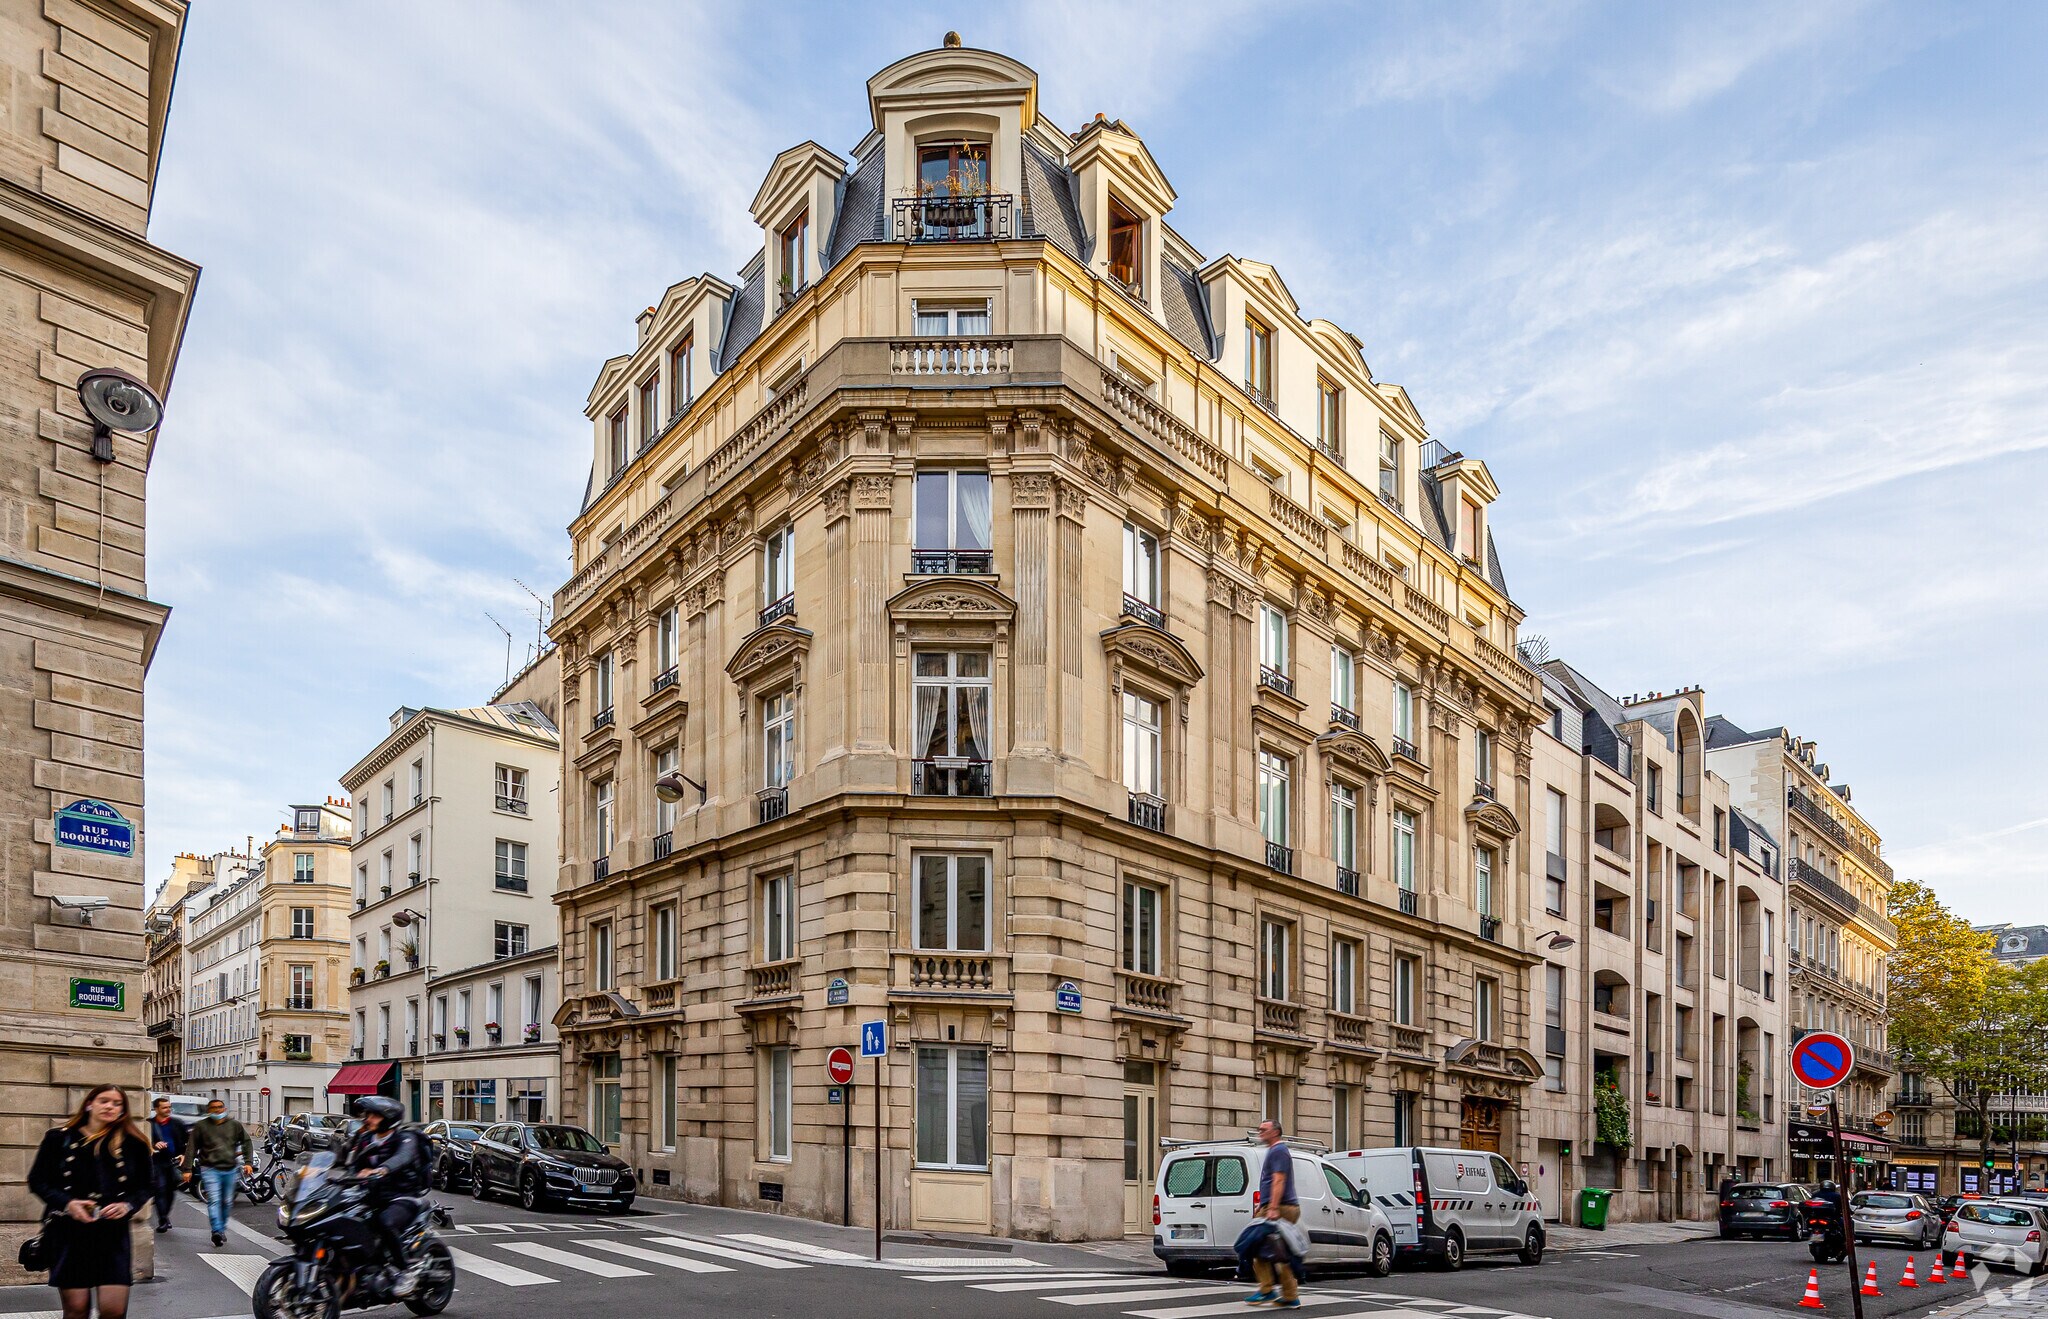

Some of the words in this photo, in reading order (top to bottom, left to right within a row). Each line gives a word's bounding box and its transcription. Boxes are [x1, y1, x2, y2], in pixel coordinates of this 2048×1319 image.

[82, 824, 109, 836] RUE
[60, 831, 130, 849] ROQUÉPINE
[90, 986, 105, 994] RUE
[78, 993, 117, 1003] ROQUÉPINE
[1465, 1167, 1487, 1178] EIFFAGE
